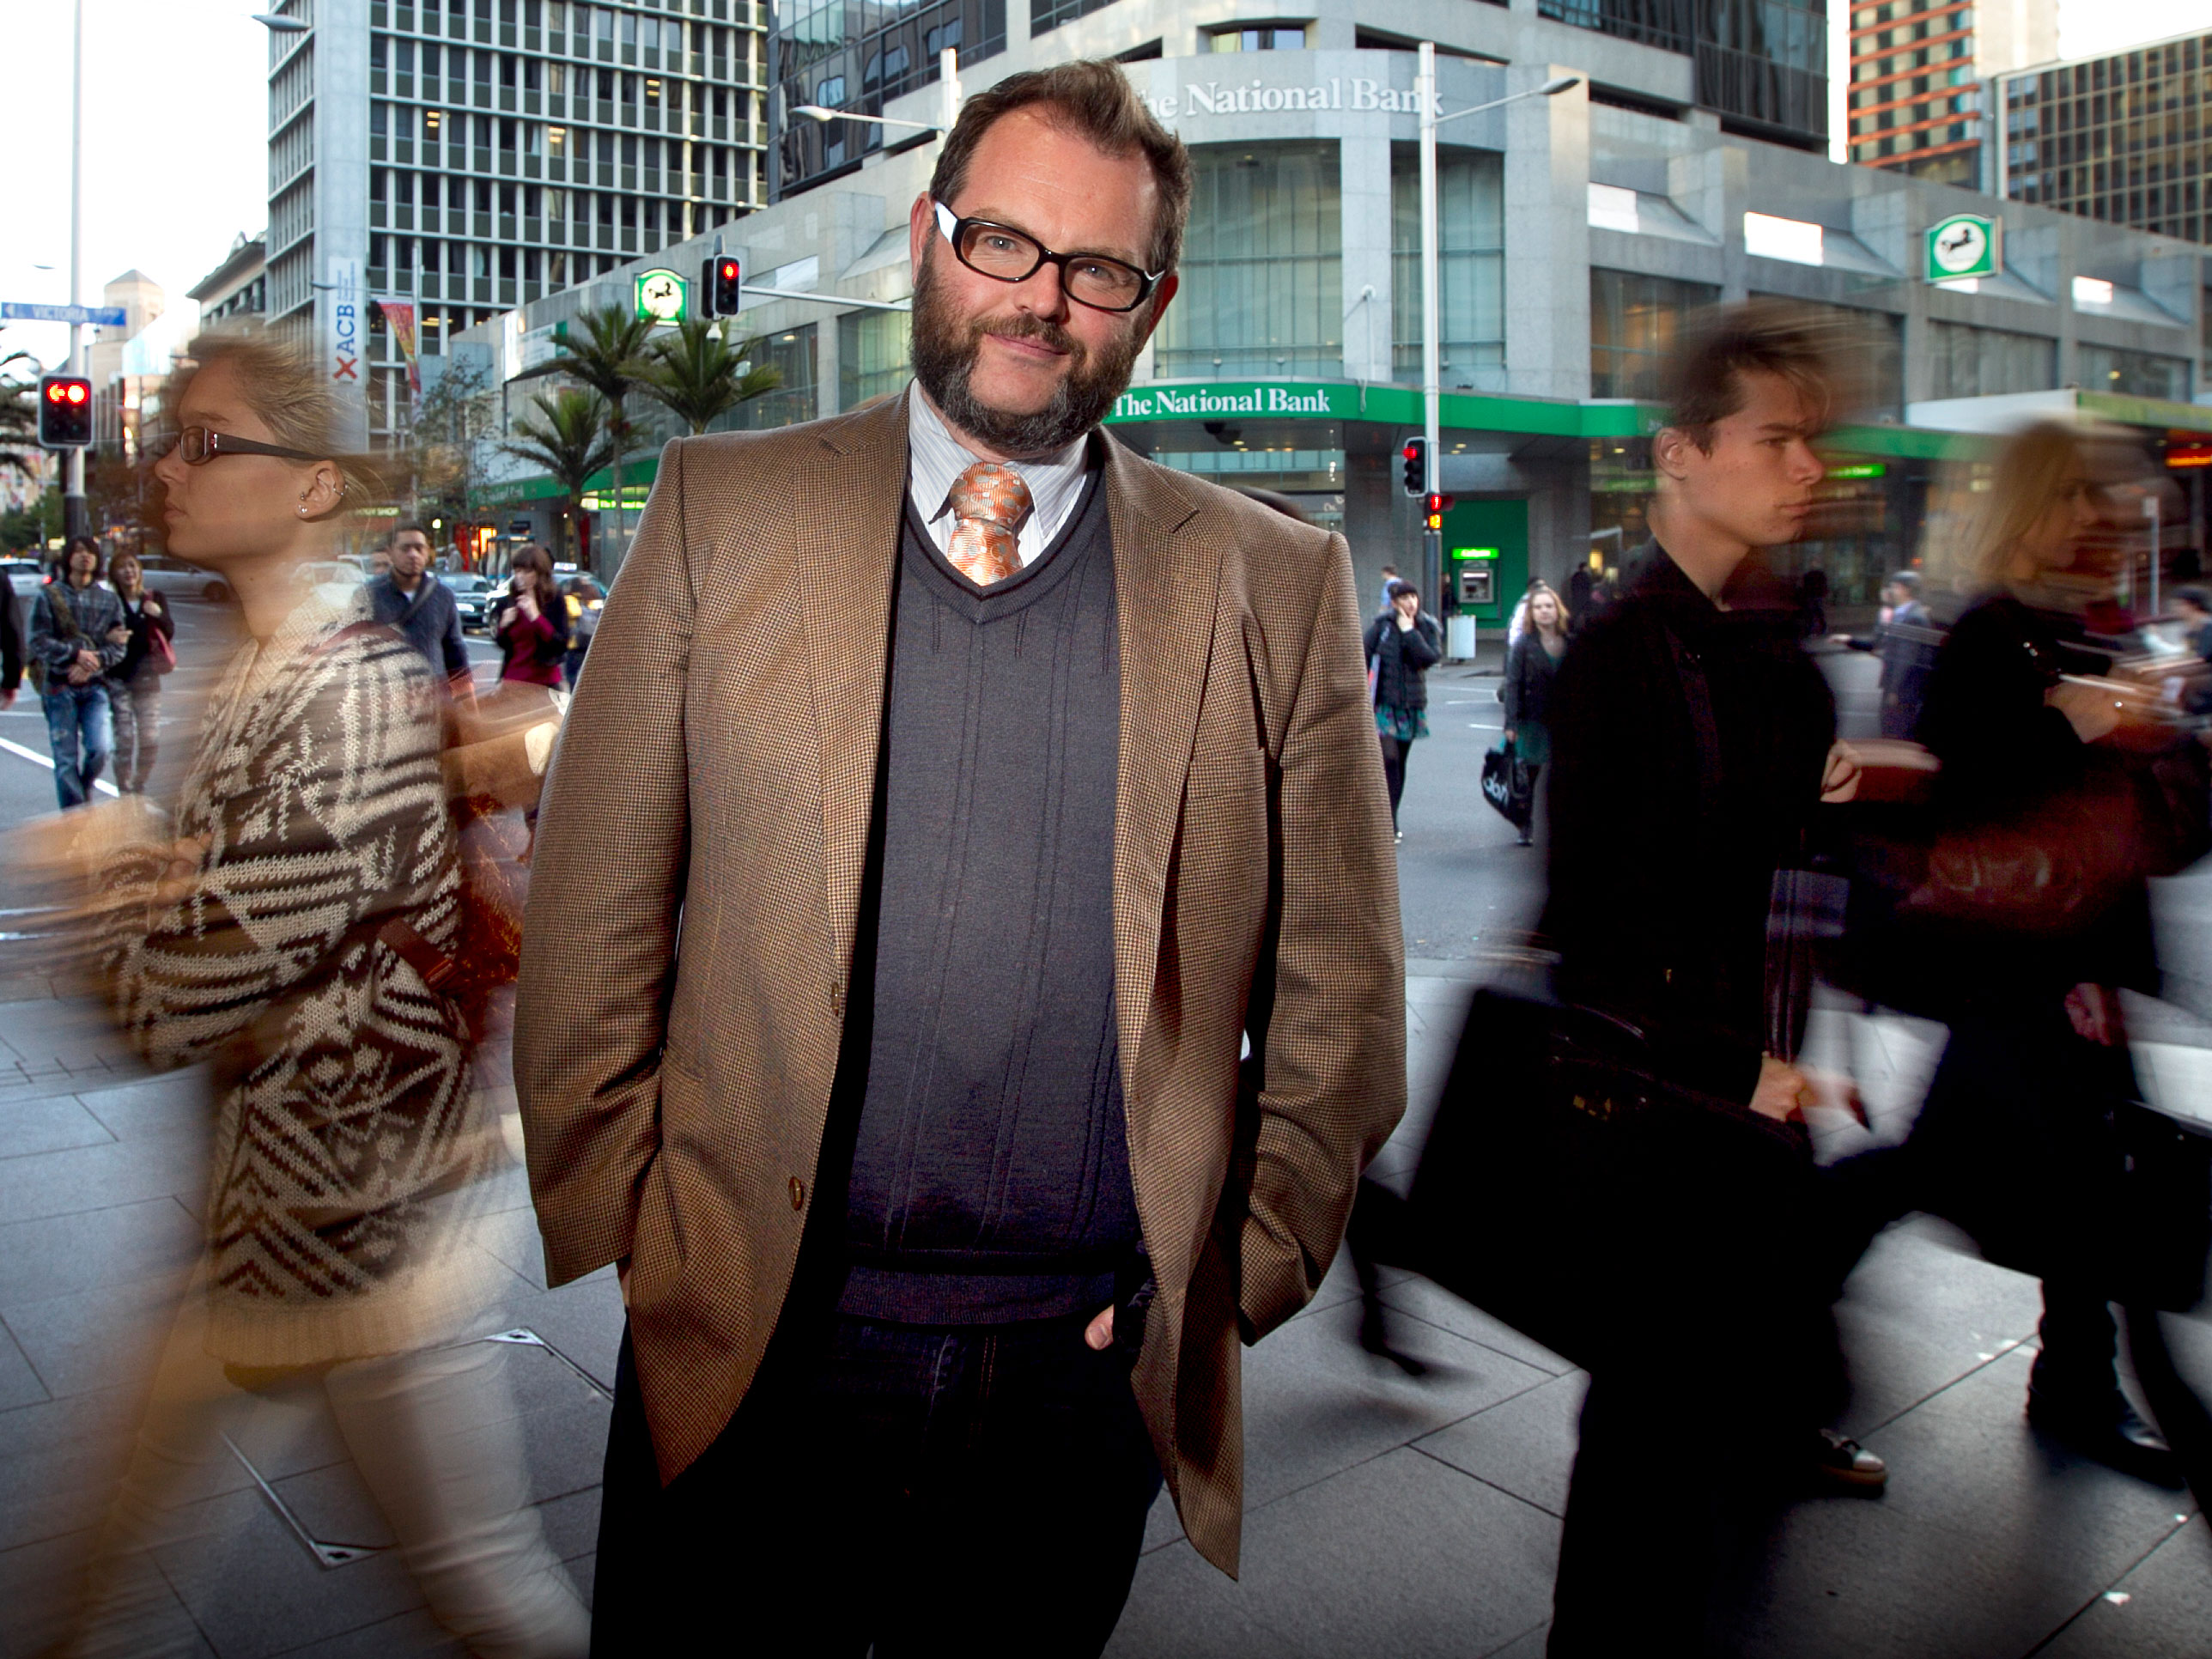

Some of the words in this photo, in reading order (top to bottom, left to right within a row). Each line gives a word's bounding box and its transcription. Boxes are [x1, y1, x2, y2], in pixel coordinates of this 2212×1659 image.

[1186, 76, 1342, 117] National
[33, 306, 89, 322] VICTORIA
[1115, 392, 1152, 417] The
[1155, 387, 1263, 415] National
[1267, 387, 1331, 413] Bank
